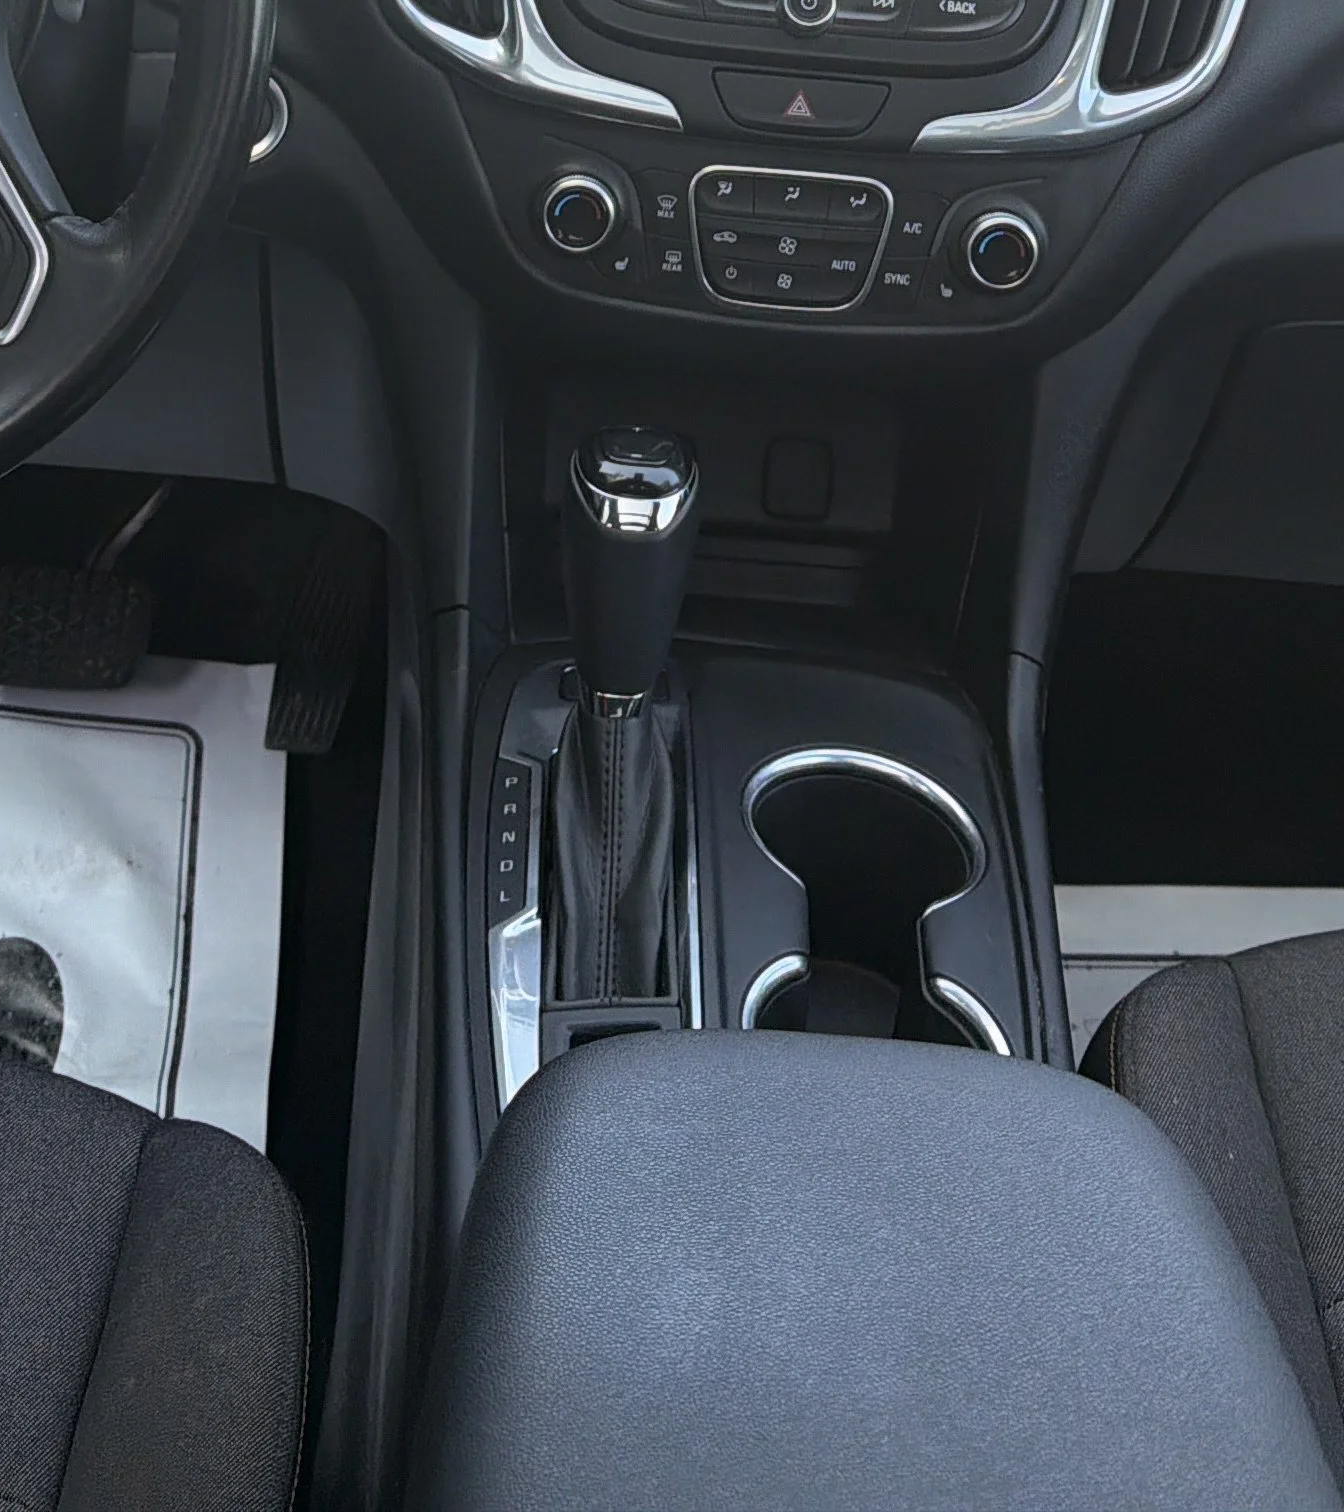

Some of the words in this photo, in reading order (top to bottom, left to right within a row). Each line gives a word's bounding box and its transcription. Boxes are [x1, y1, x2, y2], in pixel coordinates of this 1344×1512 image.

[947, 0, 976, 15] BACK
[903, 221, 923, 234] A/C
[662, 262, 682, 272] REAR
[831, 259, 856, 272] AUTO
[884, 273, 910, 286] SYNC
[505, 777, 518, 789] P
[503, 803, 517, 815] R
[502, 831, 516, 844] N
[500, 859, 514, 873] D
[499, 890, 511, 903] L
